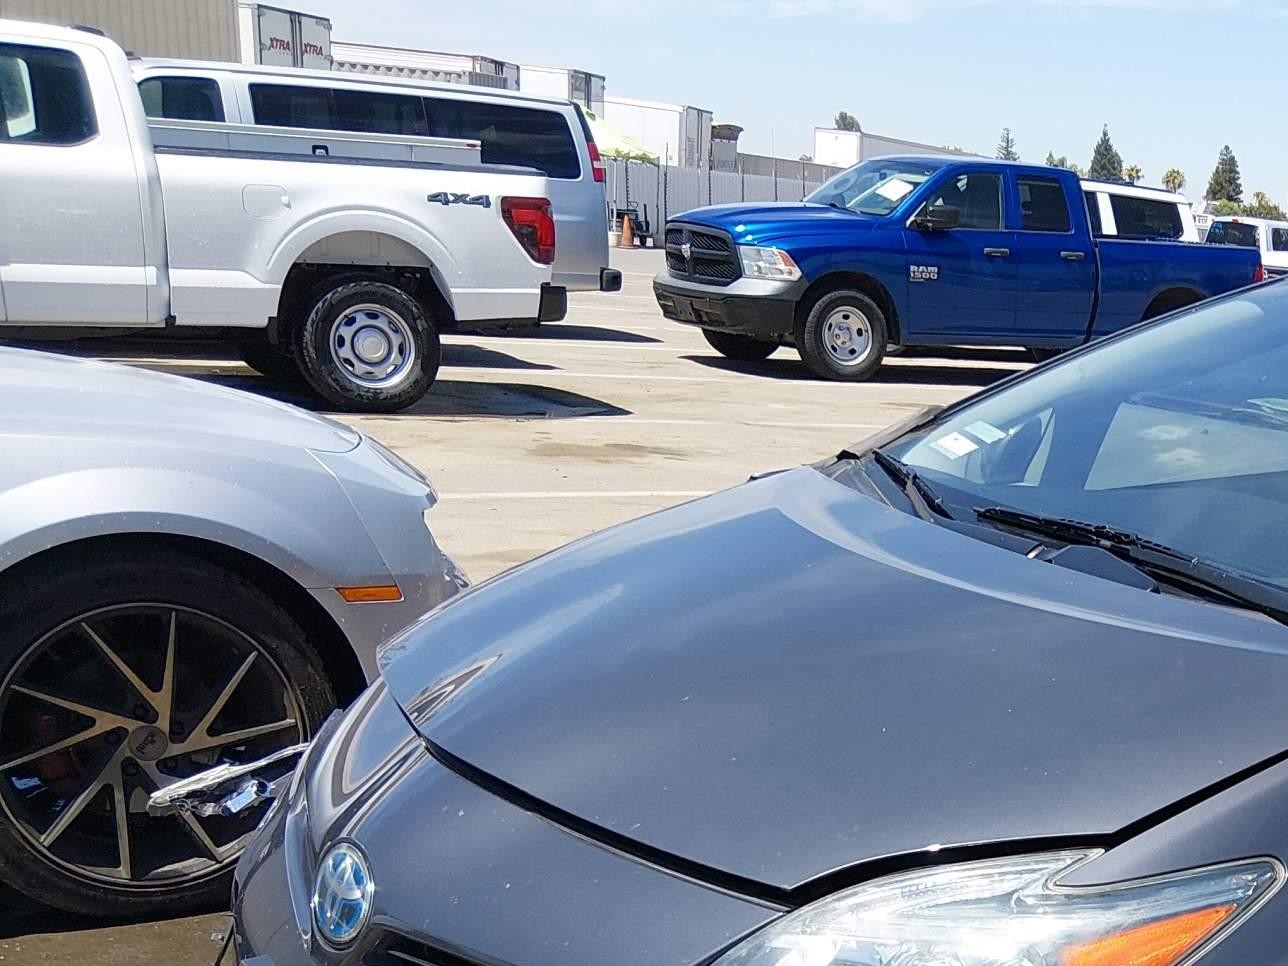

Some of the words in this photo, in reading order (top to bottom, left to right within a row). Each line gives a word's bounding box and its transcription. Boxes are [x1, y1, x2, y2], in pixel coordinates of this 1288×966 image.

[268, 37, 290, 51] XTRA
[303, 42, 323, 56] XTRA
[910, 264, 938, 273] RAM
[910, 271, 938, 280] 1500
